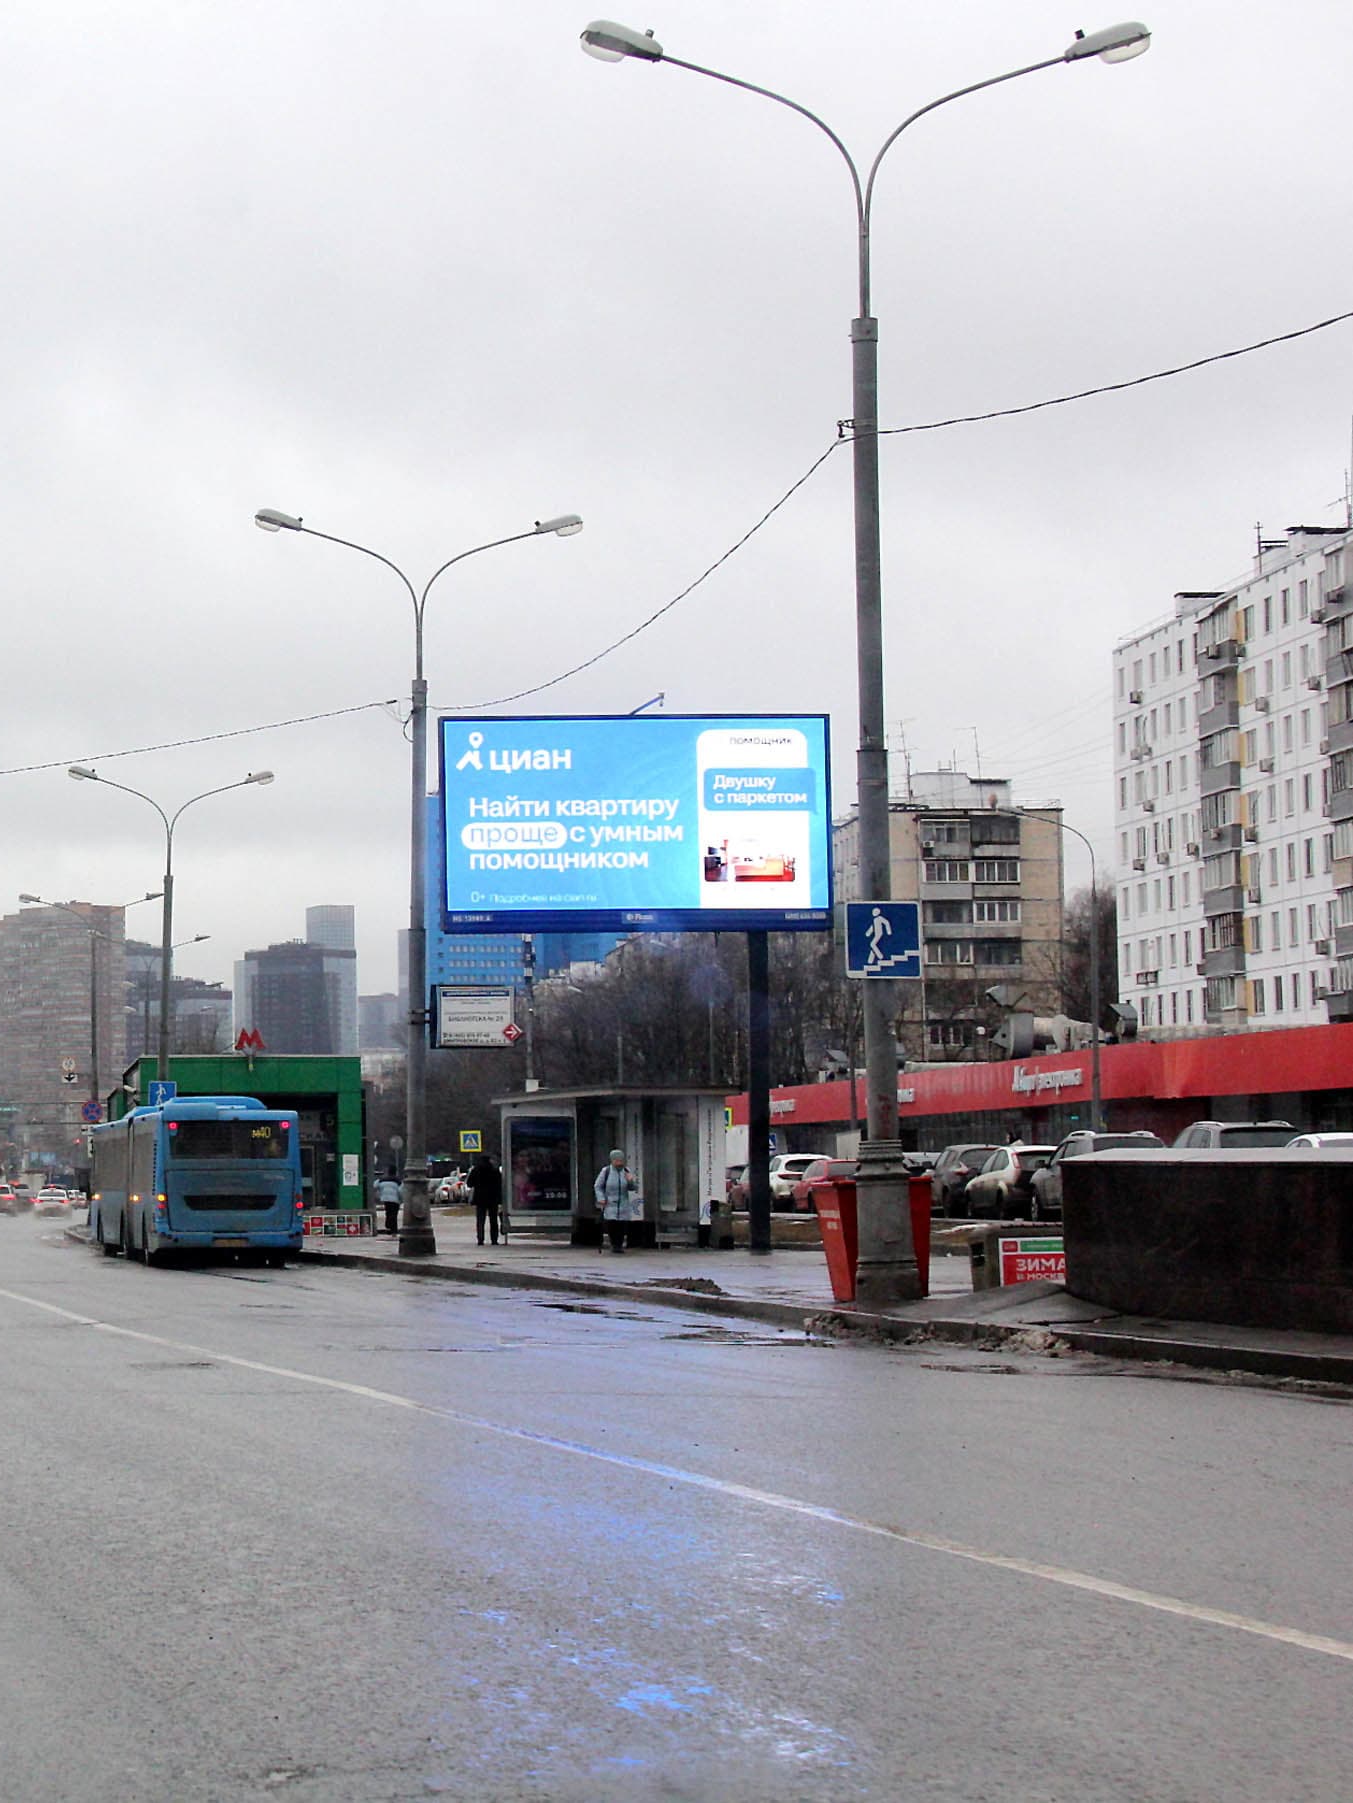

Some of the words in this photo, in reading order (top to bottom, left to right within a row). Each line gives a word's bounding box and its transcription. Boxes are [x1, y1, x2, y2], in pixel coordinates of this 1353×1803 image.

[489, 749, 571, 774] циан
[712, 774, 776, 791] Двушку
[469, 795, 550, 818] Найти
[555, 798, 680, 821] квартиру
[713, 793, 725, 804] с
[727, 793, 808, 806] паркетом
[469, 826, 559, 848] проще
[570, 826, 586, 843] с
[590, 825, 684, 846] умным
[469, 852, 649, 872] помощником
[1016, 1257, 1066, 1272] ЗИМА
[1027, 1272, 1066, 1281] МОСКВ
